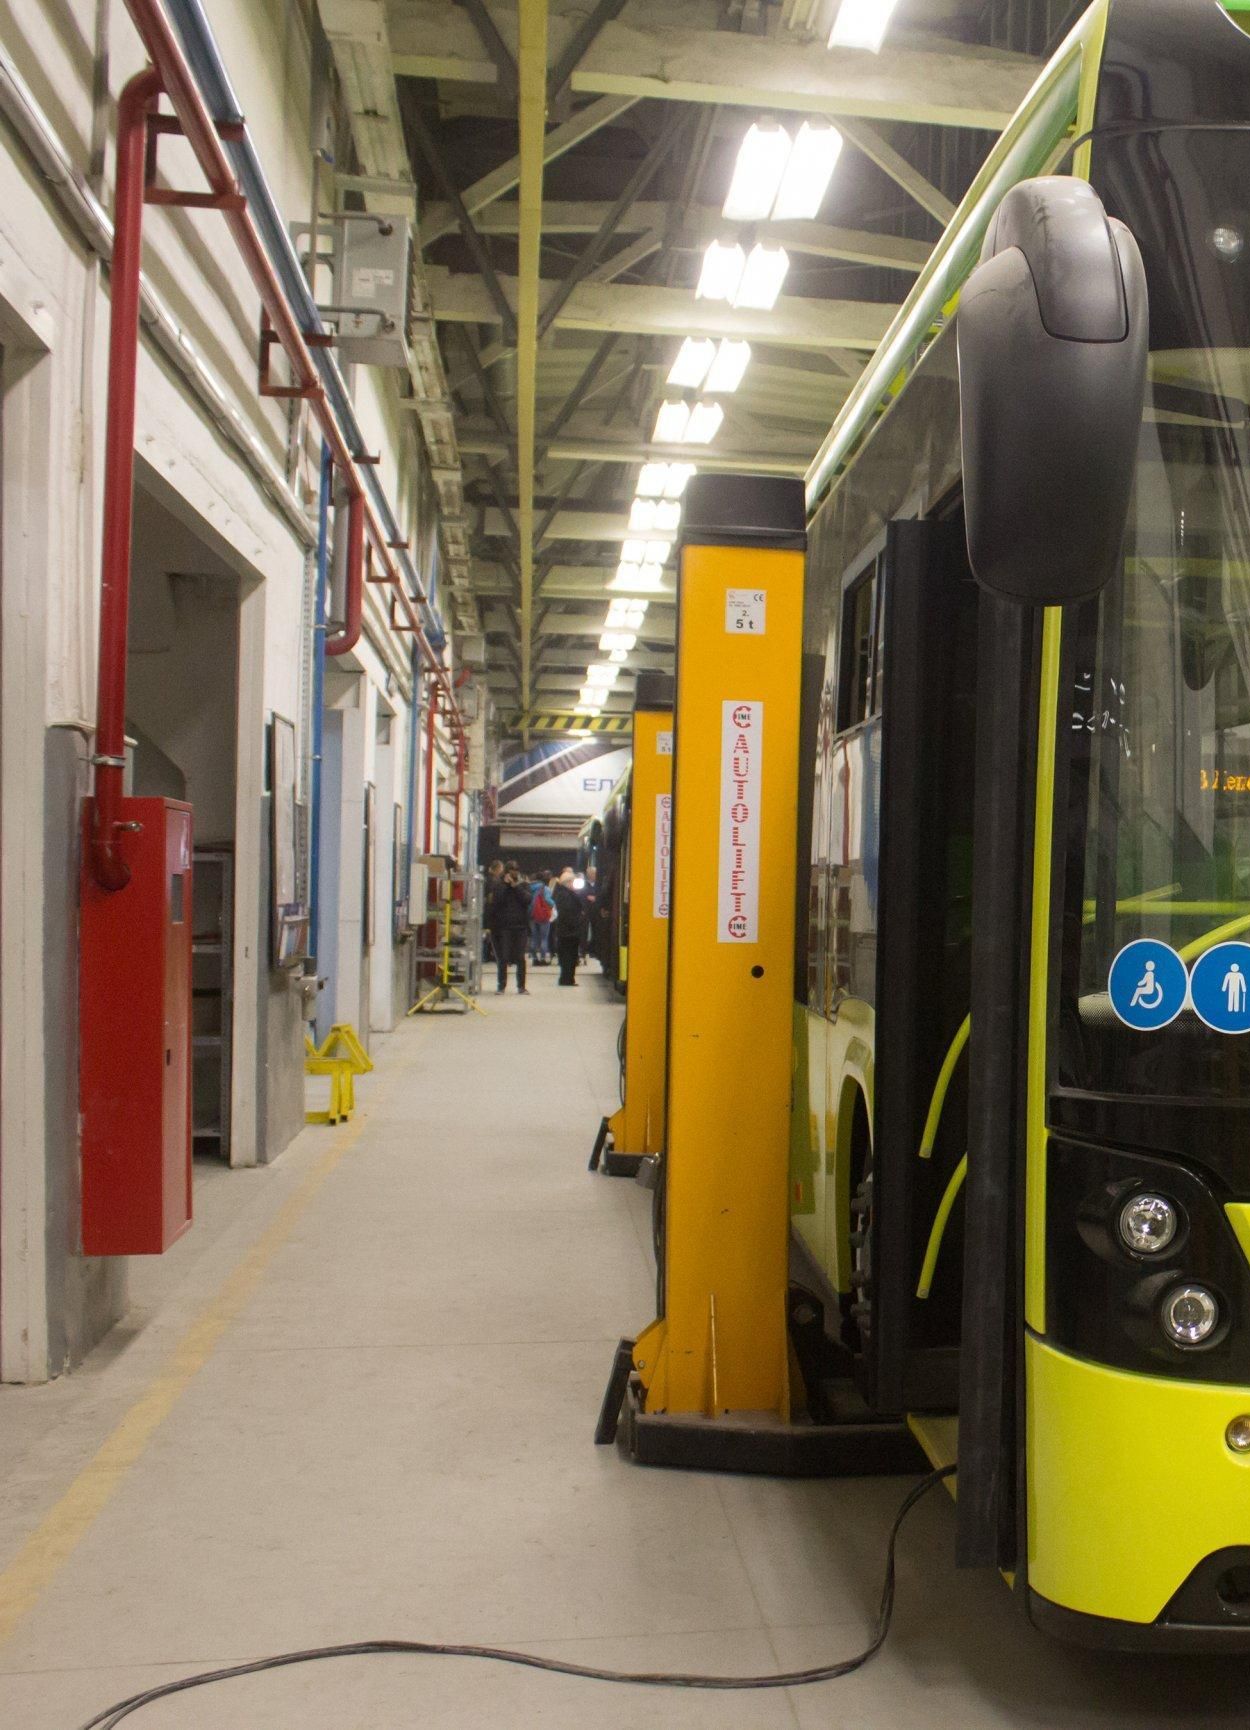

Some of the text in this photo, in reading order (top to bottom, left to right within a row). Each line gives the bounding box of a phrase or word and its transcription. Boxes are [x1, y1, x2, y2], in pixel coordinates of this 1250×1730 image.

[753, 594, 764, 602] CE
[736, 619, 754, 630] 5 t
[731, 734, 749, 912] AUTOLIFT
